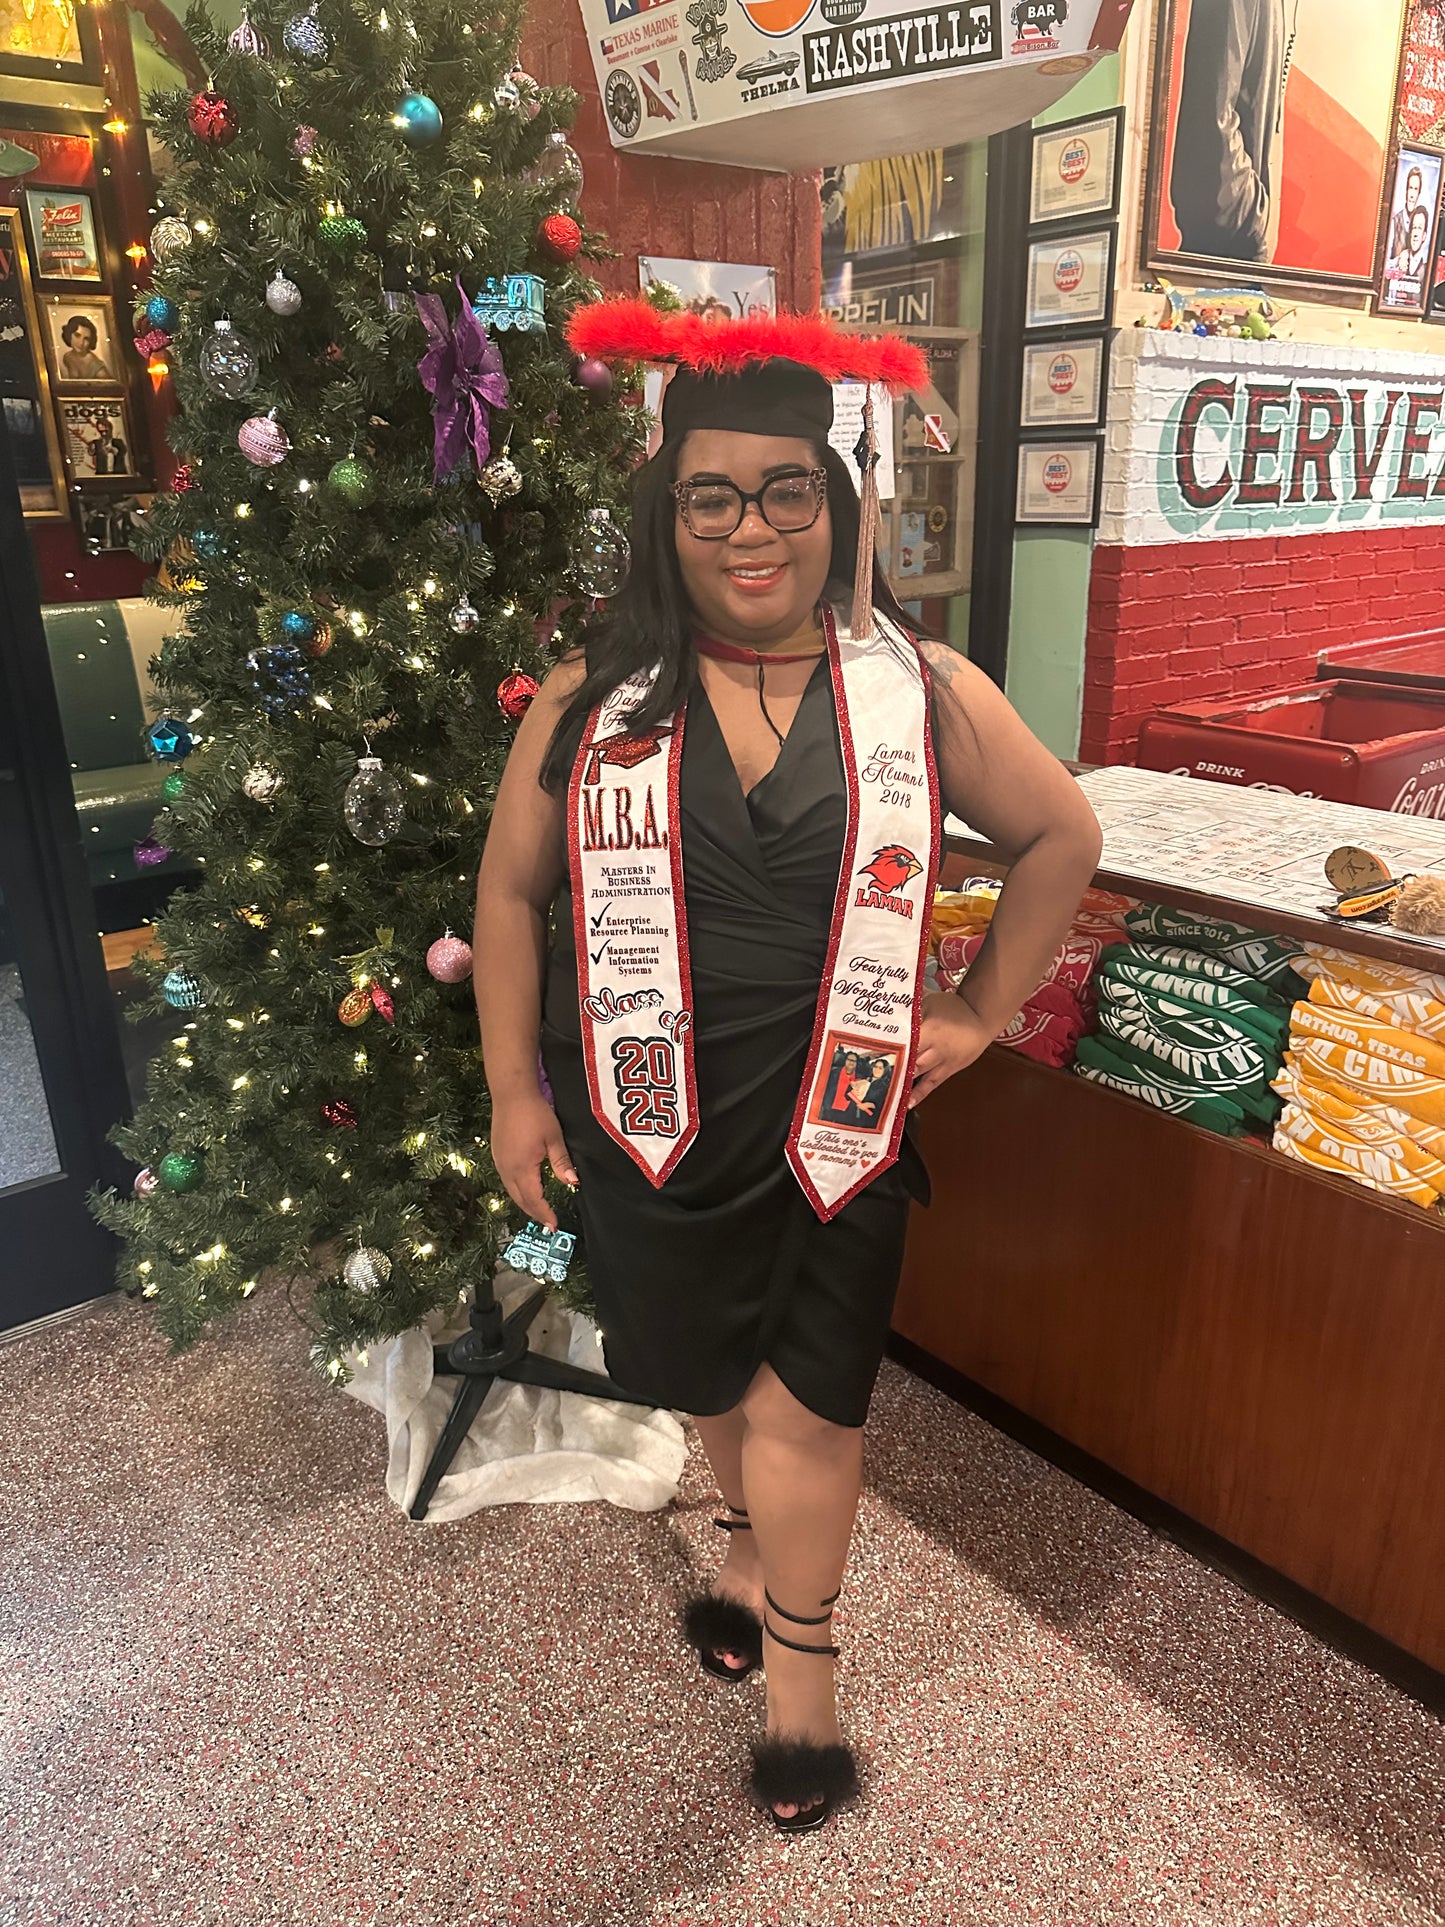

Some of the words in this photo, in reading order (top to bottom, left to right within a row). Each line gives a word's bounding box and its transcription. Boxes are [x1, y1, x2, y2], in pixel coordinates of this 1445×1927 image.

[839, 2, 862, 16] HABITS
[1027, 4, 1055, 18] BAR
[613, 28, 641, 49] TEXAS
[642, 14, 679, 40] MARINE
[809, 5, 993, 83] NASHVILLE
[741, 78, 800, 102] THELMA
[1065, 150, 1084, 160] BEST
[1067, 157, 1086, 168] BEST
[49, 209, 77, 221] Felix
[1060, 261, 1077, 270] BEST
[1061, 268, 1080, 277] BEST
[822, 292, 929, 326] PPELIN
[64, 404, 121, 419] dogs
[1176, 375, 1445, 508] CERVE
[868, 743, 916, 764] Lamar
[862, 762, 924, 787] Alumni
[1195, 761, 1245, 778] DRINK
[880, 788, 912, 808] 2018
[582, 784, 669, 851] M.B.A.
[601, 866, 643, 876] MASTERS
[646, 865, 656, 874] IN
[607, 877, 651, 886] BUSINESS
[591, 887, 671, 898] ADMINISTRATION
[855, 888, 913, 920] LAMAR
[606, 916, 651, 927] Enterprise
[590, 928, 629, 937] Resource
[631, 926, 669, 938] Planning
[1167, 925, 1201, 936] SINCE
[1203, 926, 1231, 943] 2014
[606, 946, 660, 956] Management
[608, 956, 659, 966] Information
[849, 956, 909, 982] Fearfully
[618, 966, 652, 977] Systems
[872, 979, 886, 988] &
[833, 979, 914, 1008] Wonderfully
[583, 987, 664, 1024] Class
[854, 996, 894, 1017] Made
[659, 1010, 692, 1046] of
[842, 1013, 881, 1030] Psalms
[883, 1024, 899, 1034] 139
[1291, 1009, 1363, 1048] ARTHUR,
[1368, 1037, 1426, 1069] TEXAS
[612, 1038, 676, 1088] 20
[620, 1087, 680, 1138] 25
[814, 1130, 841, 1144] This
[842, 1138, 867, 1147] one's
[800, 1139, 847, 1154] dedicated
[849, 1147, 860, 1155] to
[859, 1151, 878, 1159] you
[818, 1154, 857, 1167] mommy
